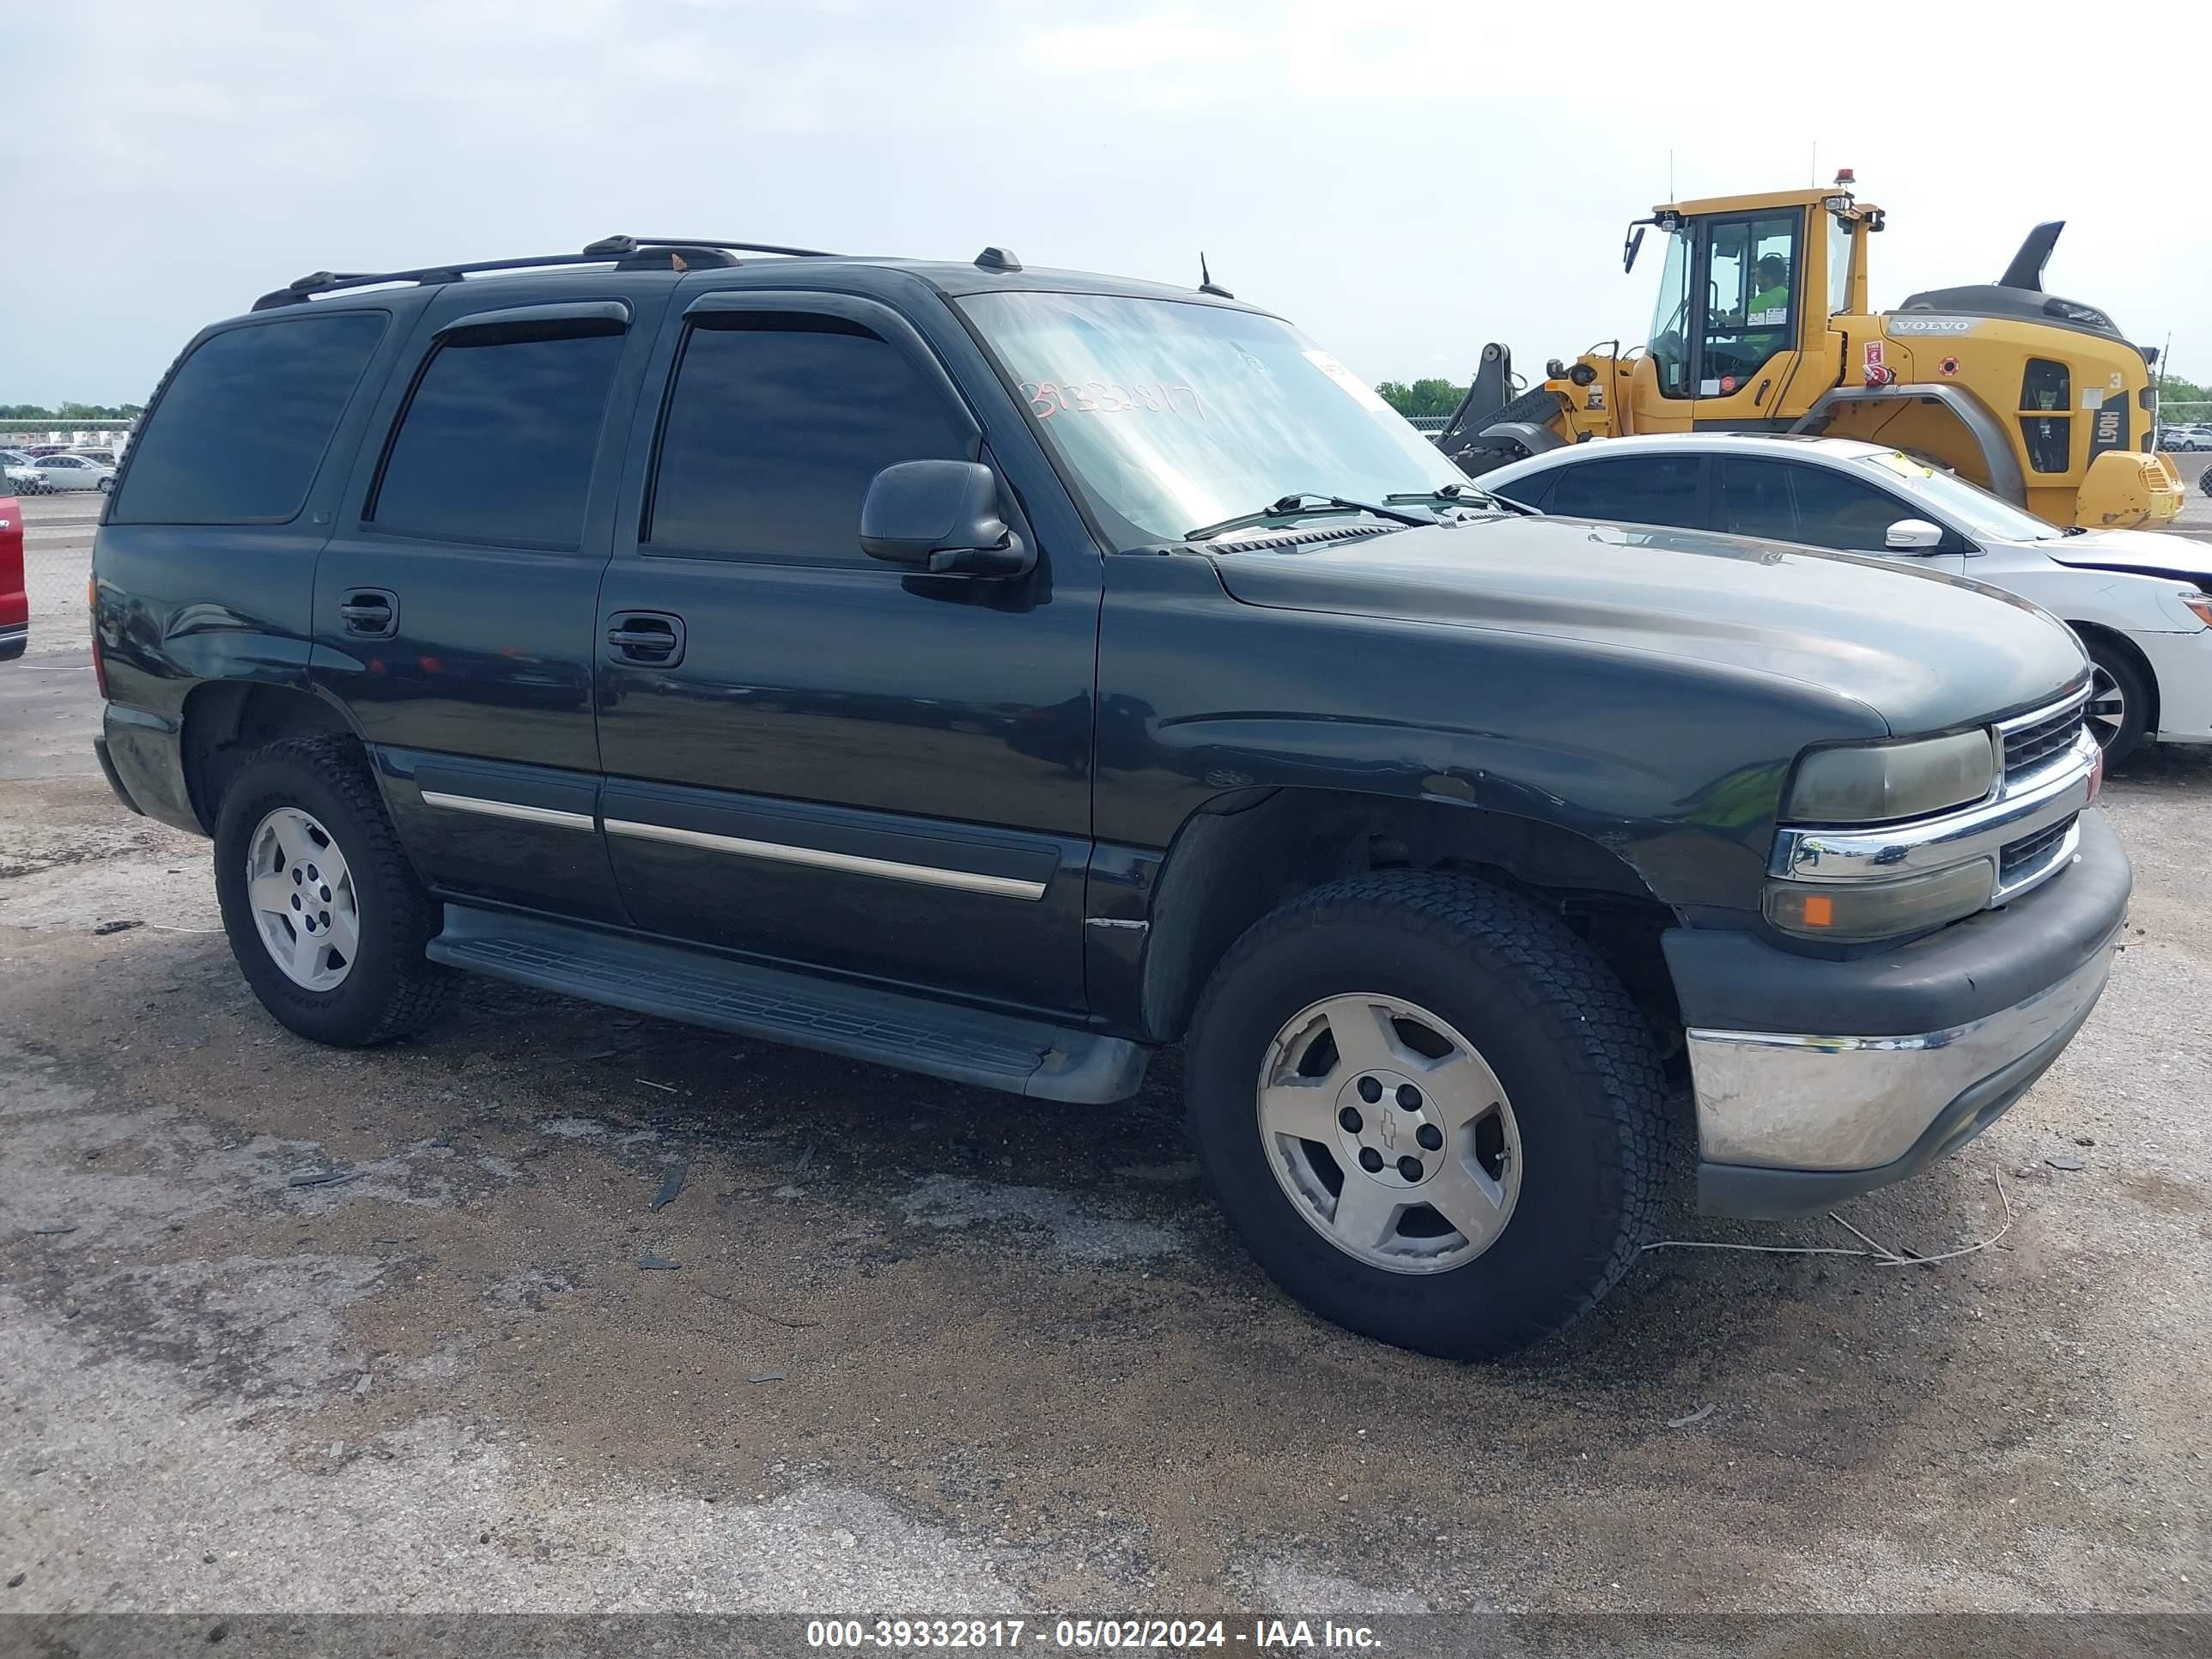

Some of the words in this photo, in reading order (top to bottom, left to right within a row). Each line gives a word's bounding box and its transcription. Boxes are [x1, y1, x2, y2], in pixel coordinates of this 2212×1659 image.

[1895, 320, 1970, 331] VOLVO
[2109, 372, 2122, 389] 3
[1019, 380, 1207, 418] 39332817
[2097, 411, 2120, 443] L90H
